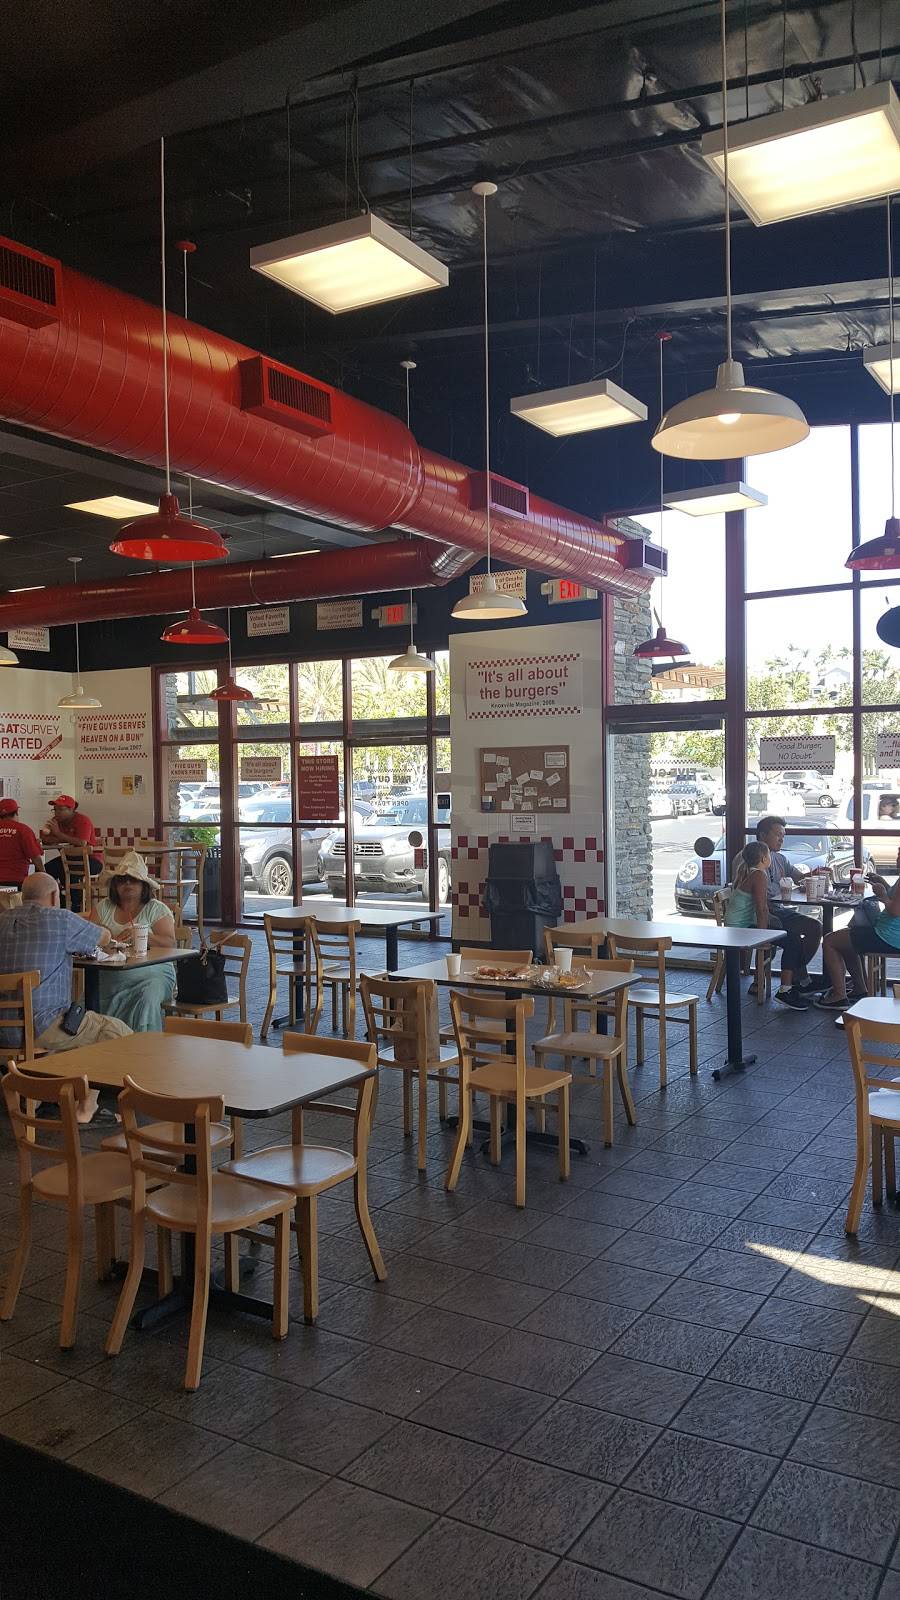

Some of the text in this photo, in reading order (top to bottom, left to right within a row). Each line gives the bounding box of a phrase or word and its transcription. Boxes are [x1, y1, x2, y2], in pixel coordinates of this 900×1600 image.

[560, 579, 581, 600] EXIT
[265, 612, 286, 620] Favorite
[387, 607, 404, 624] EXIT
[478, 665, 568, 683] "It's all about
[480, 681, 566, 700] the burgers"
[99, 722, 117, 731] GUYS
[118, 720, 146, 730] SERVES
[1, 737, 43, 749] RATED
[80, 734, 108, 744] HEAVEN
[108, 734, 119, 742] ON
[119, 734, 125, 742] A
[797, 742, 822, 751] Burger,
[879, 749, 893, 757] and
